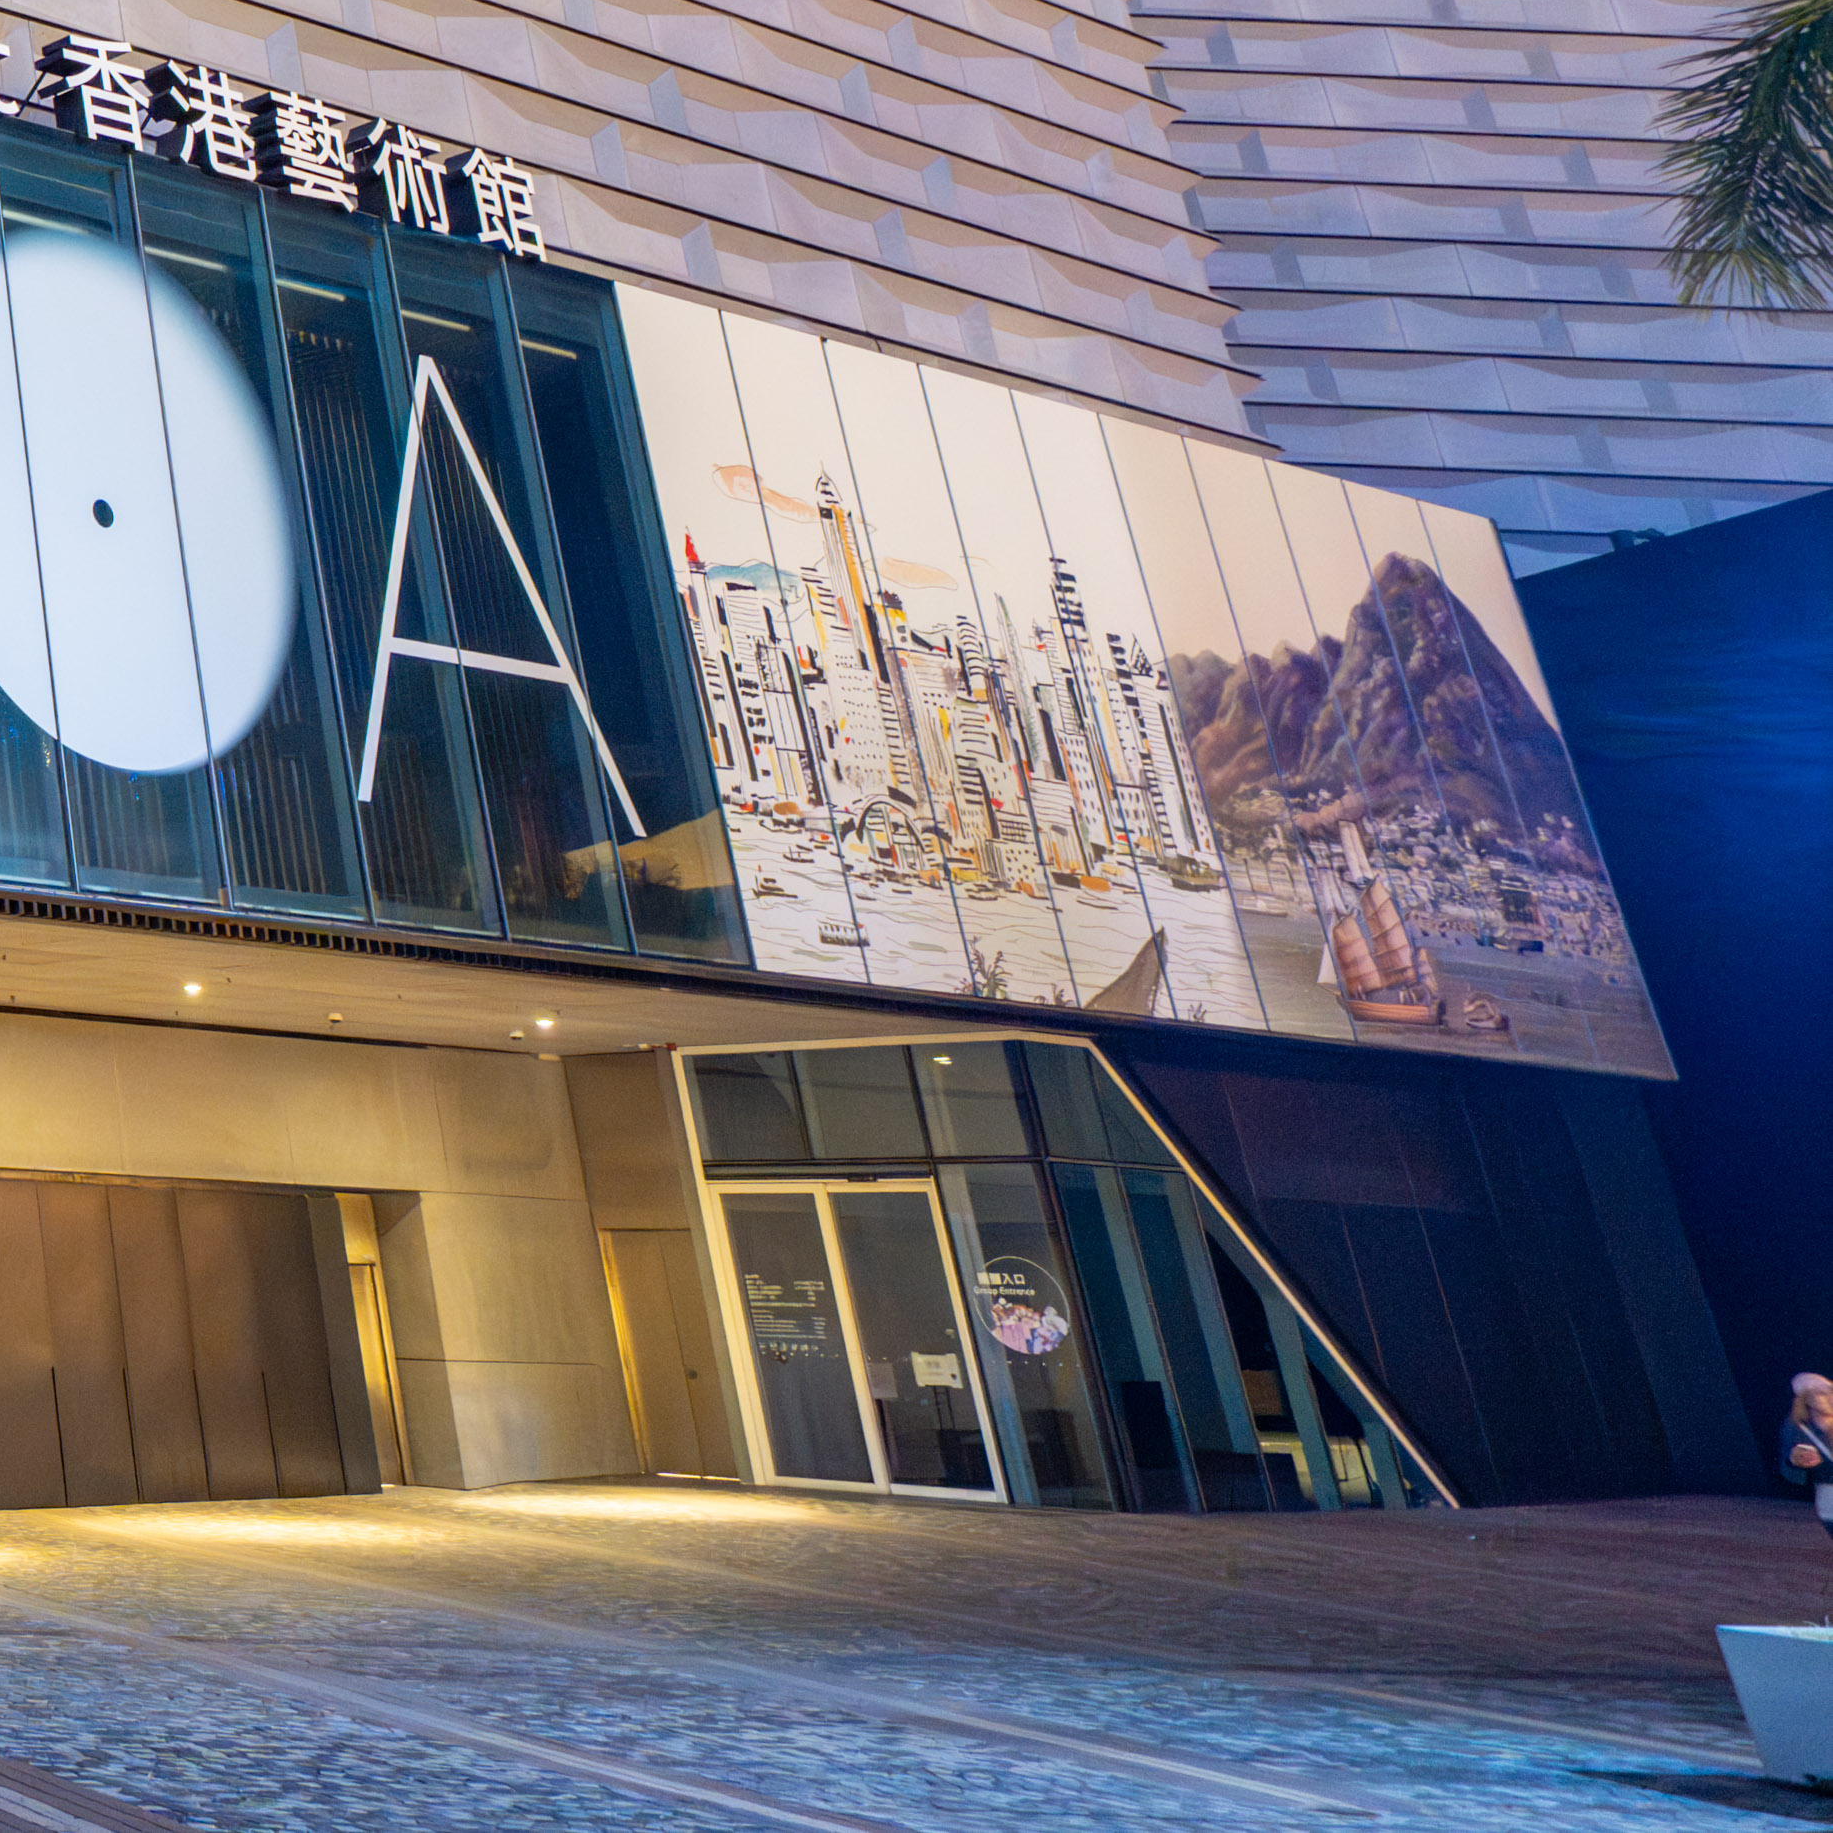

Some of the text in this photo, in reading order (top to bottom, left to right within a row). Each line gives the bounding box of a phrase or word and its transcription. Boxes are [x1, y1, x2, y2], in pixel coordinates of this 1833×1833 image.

[59, 35, 547, 262] 香港藝術館
